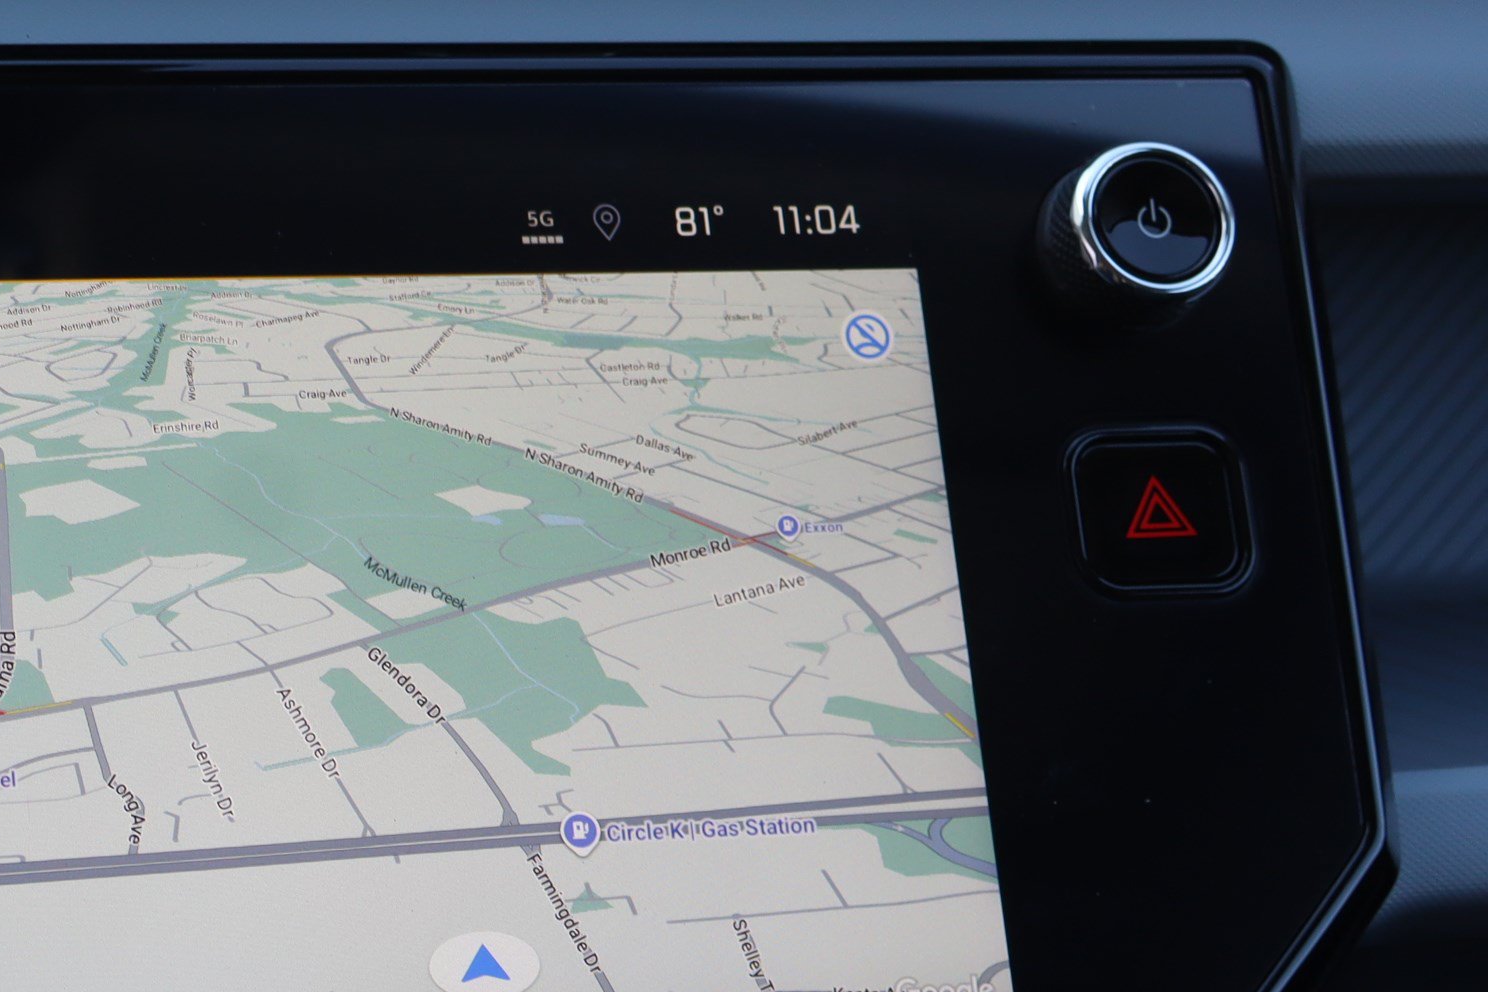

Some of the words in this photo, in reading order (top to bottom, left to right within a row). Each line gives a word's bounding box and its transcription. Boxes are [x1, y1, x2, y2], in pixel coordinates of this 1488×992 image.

[527, 210, 555, 228] 5G
[674, 205, 725, 237] 81°
[772, 204, 861, 236] 11:04
[21, 319, 33, 327] Rd
[61, 318, 109, 332] Nottingham
[227, 336, 238, 345] Ln
[486, 350, 513, 363] Tangle
[515, 344, 525, 355] Dr
[348, 356, 378, 366] Tangle
[381, 355, 390, 363] Dr
[600, 362, 644, 371] Castleton
[648, 362, 660, 371] Rd
[298, 389, 324, 402] Craig
[326, 388, 347, 400] Ave
[622, 377, 646, 387] Craig
[650, 376, 668, 385] Ave
[153, 421, 202, 434] Erinshire
[204, 420, 219, 431] Rd
[390, 407, 399, 417] N
[402, 411, 440, 430] Sharon
[442, 424, 474, 443] Amity
[476, 434, 492, 446] Rd
[839, 419, 858, 432] Ave
[579, 443, 630, 468] Summey
[632, 459, 656, 477] Ave
[635, 434, 669, 455] Dallas
[670, 447, 694, 462] Ave
[525, 448, 535, 460] N
[538, 452, 583, 479] Sharon
[585, 470, 624, 497] Amity
[625, 486, 644, 503] Rd
[650, 545, 707, 568] Monroe
[710, 538, 731, 554] Rd
[364, 556, 429, 595] McMullen
[431, 585, 468, 612] Creek
[713, 583, 776, 607] Lantana
[778, 575, 806, 592] Ave
[0, 631, 17, 655] Rd
[366, 647, 429, 709] Glendora
[425, 704, 447, 725] Dr
[276, 687, 327, 759] Ashmore
[321, 756, 340, 780] Dr
[191, 740, 223, 798] Jerilyn
[215, 796, 235, 819] Dr
[107, 773, 141, 812] Long
[130, 810, 147, 845] Ave
[607, 823, 664, 841] Circle
[669, 823, 685, 837] K
[701, 821, 739, 837] Gas
[745, 817, 816, 836] Station
[527, 852, 588, 953] Farmingdale
[583, 952, 602, 974] Dr
[732, 919, 764, 980] Shelley
